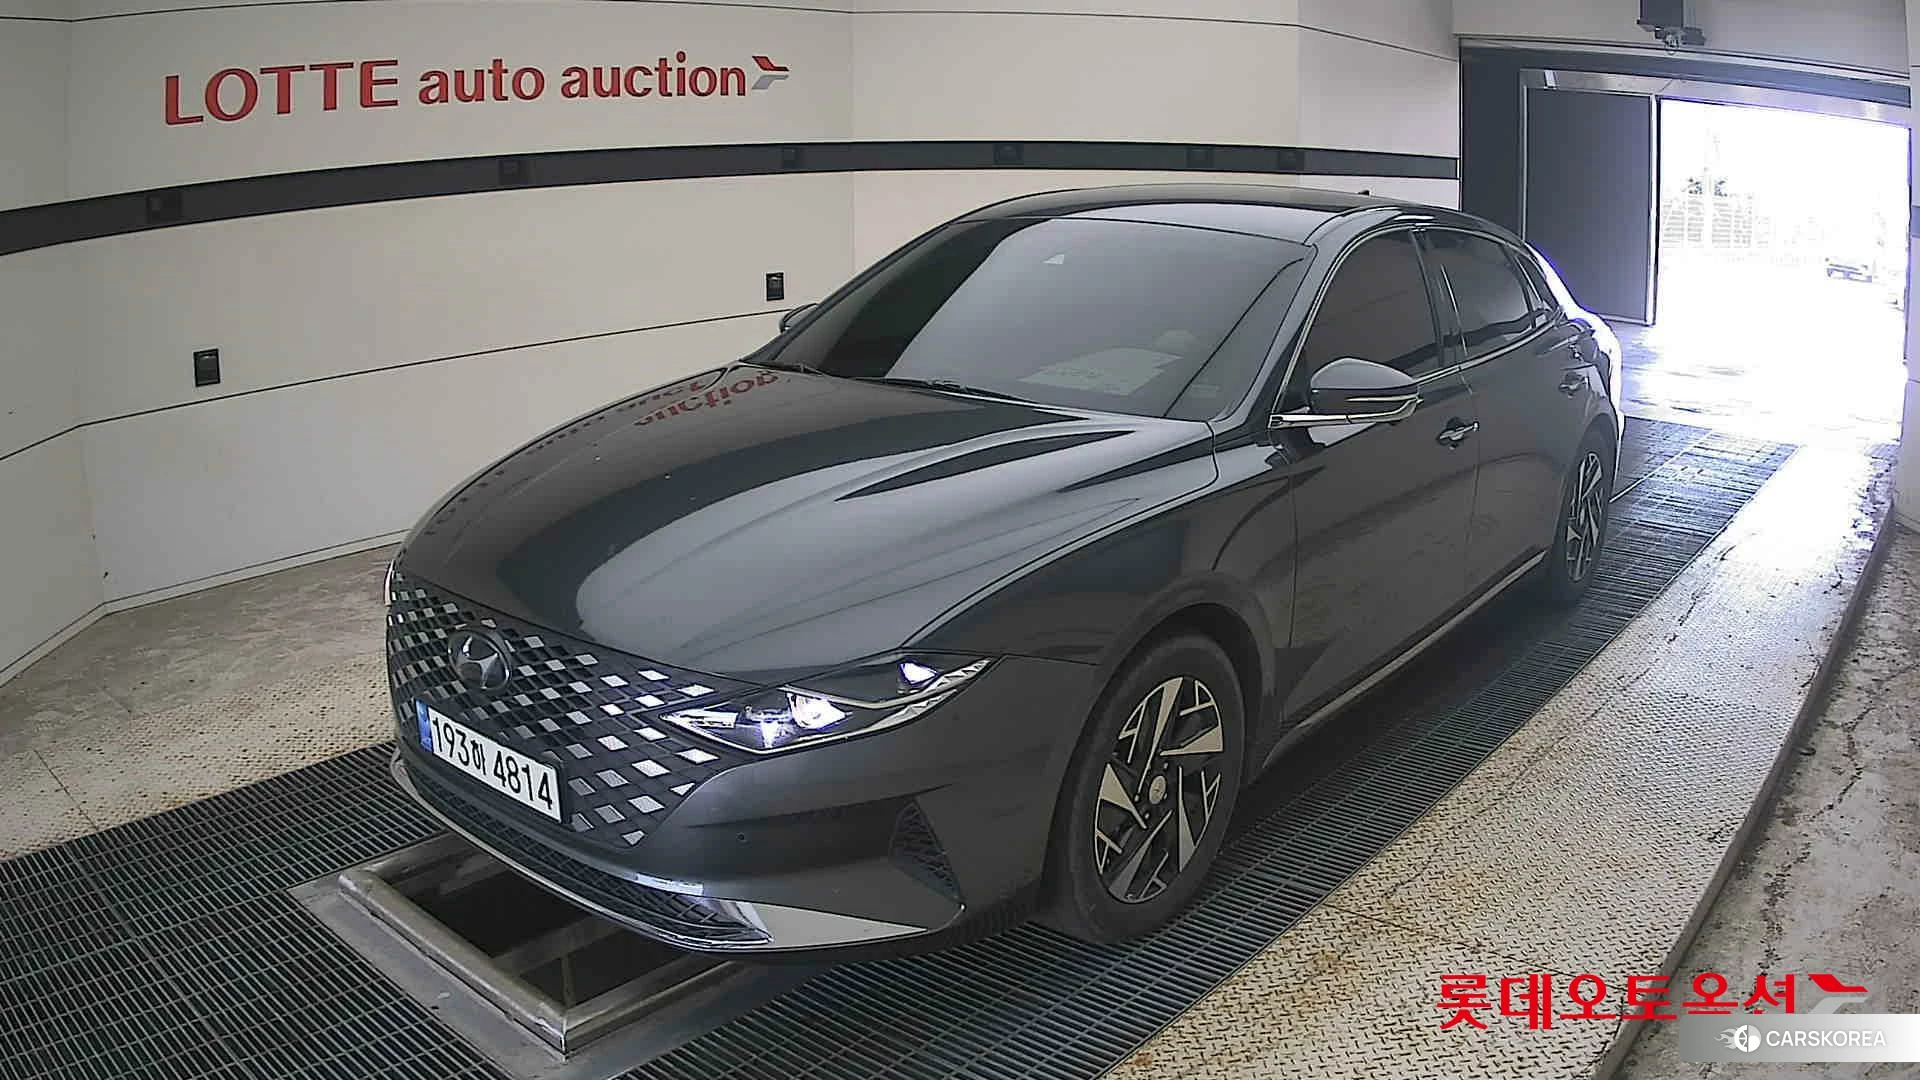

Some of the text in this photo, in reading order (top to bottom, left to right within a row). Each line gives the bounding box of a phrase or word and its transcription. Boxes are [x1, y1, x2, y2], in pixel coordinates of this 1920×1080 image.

[165, 51, 747, 126] LOTTE auto auction
[432, 717, 553, 810] 193하 4814
